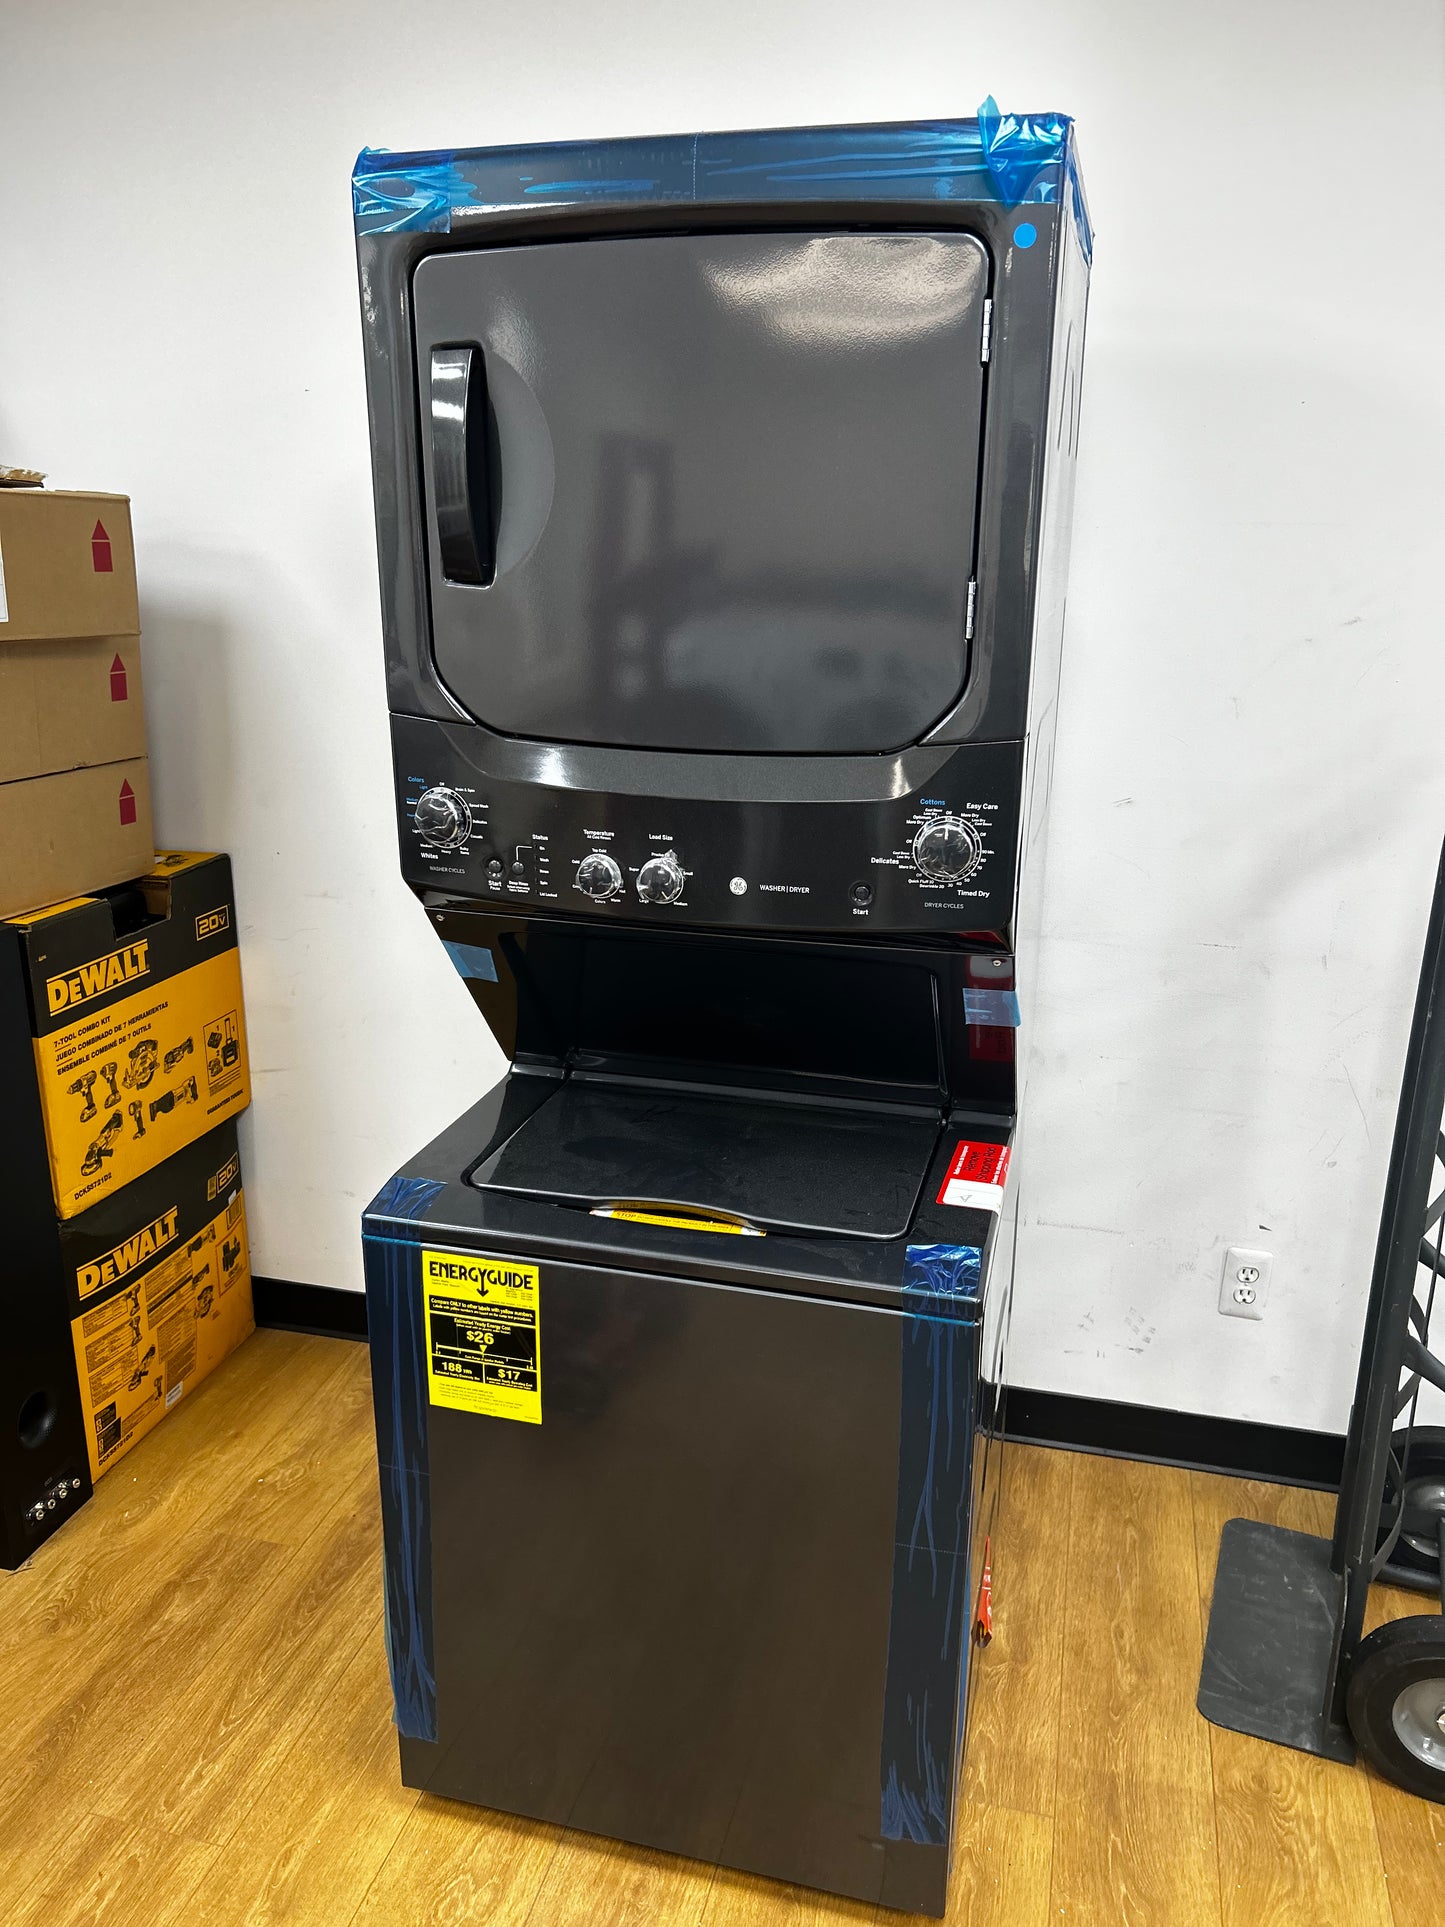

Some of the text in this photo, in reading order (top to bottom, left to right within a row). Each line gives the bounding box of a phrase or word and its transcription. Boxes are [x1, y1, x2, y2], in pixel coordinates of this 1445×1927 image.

[966, 802, 981, 810] Easy
[583, 829, 615, 837] Temperature
[421, 852, 439, 860] Whites
[871, 857, 899, 865] Delicates
[429, 865, 448, 873] WASHER
[730, 876, 747, 896] GE
[759, 883, 811, 894] WASHER DRYER
[978, 890, 990, 899] Dry
[852, 907, 869, 916] Start
[53, 1015, 111, 1048] 7-TOOL COMBO KIT
[56, 1047, 77, 1062] JUEGO
[77, 1030, 113, 1051] COMBINADO
[113, 1024, 122, 1033] DE
[127, 1001, 169, 1026] HERRAMIENTAS
[57, 1055, 90, 1076] ENSEMBLE
[91, 1040, 118, 1058] COMBINÉ
[118, 1036, 127, 1045] DE
[132, 1023, 152, 1037] OUTILS
[616, 1210, 637, 1220] STOP
[429, 1261, 534, 1292] ENERGYGUIDE
[466, 1330, 495, 1345] $26
[442, 1362, 462, 1373] 188
[497, 1368, 521, 1380] $17
